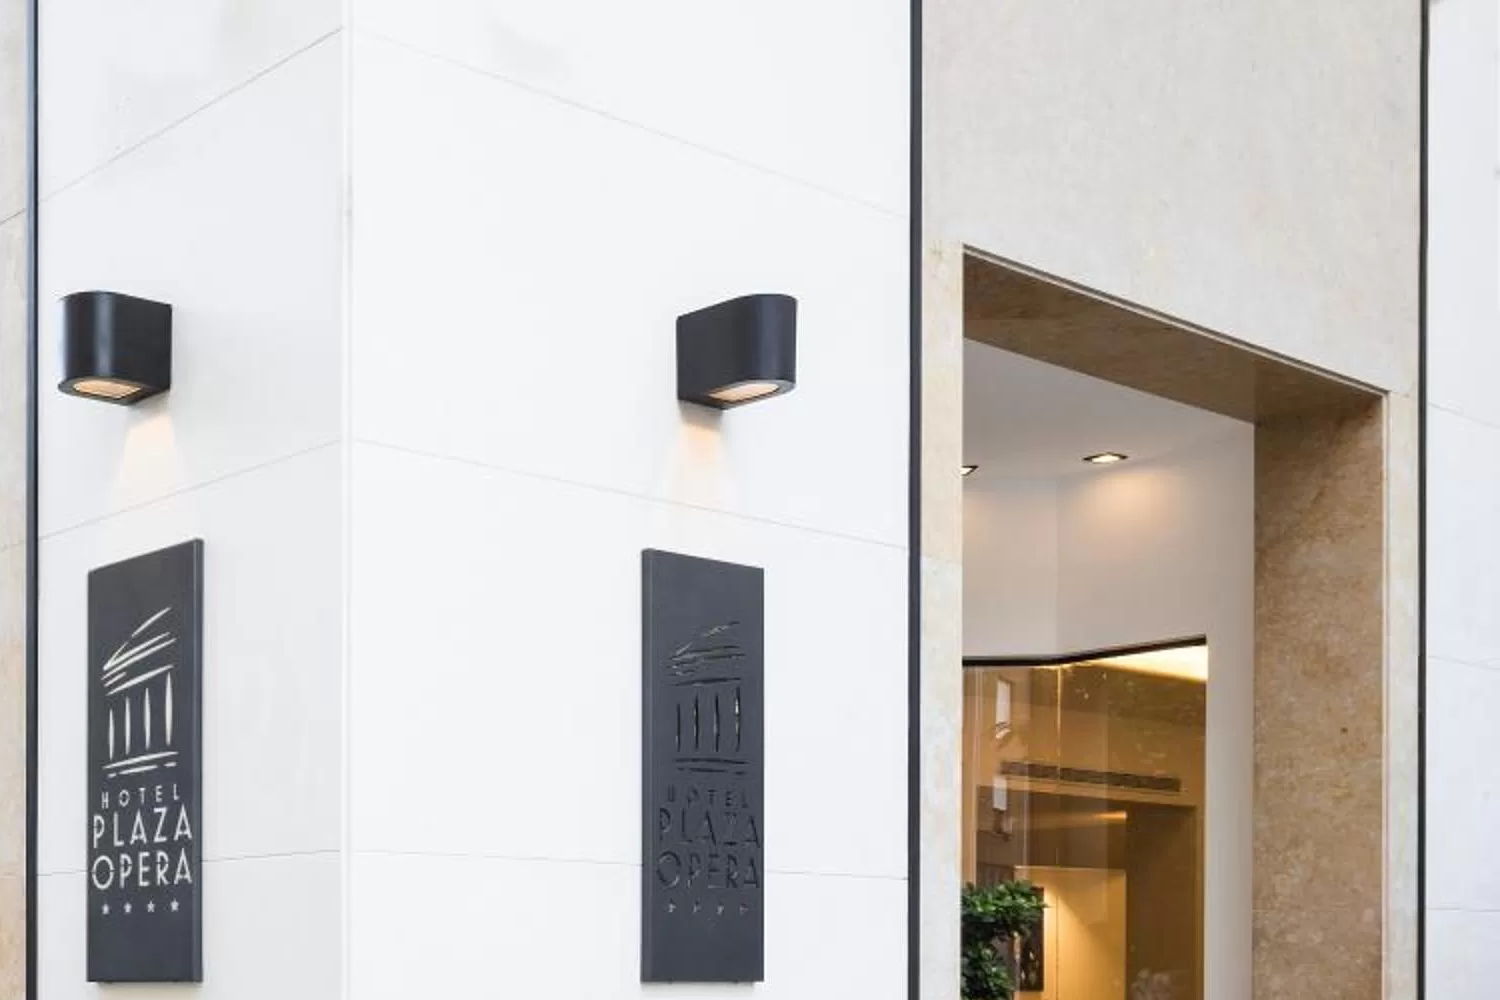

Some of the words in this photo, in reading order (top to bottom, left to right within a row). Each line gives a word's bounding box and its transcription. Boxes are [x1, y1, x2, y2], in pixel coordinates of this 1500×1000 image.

[101, 783, 179, 808] HOTEL
[93, 803, 192, 848] PLAZA
[92, 847, 192, 889] OPERA
[656, 850, 760, 889] OPERA
